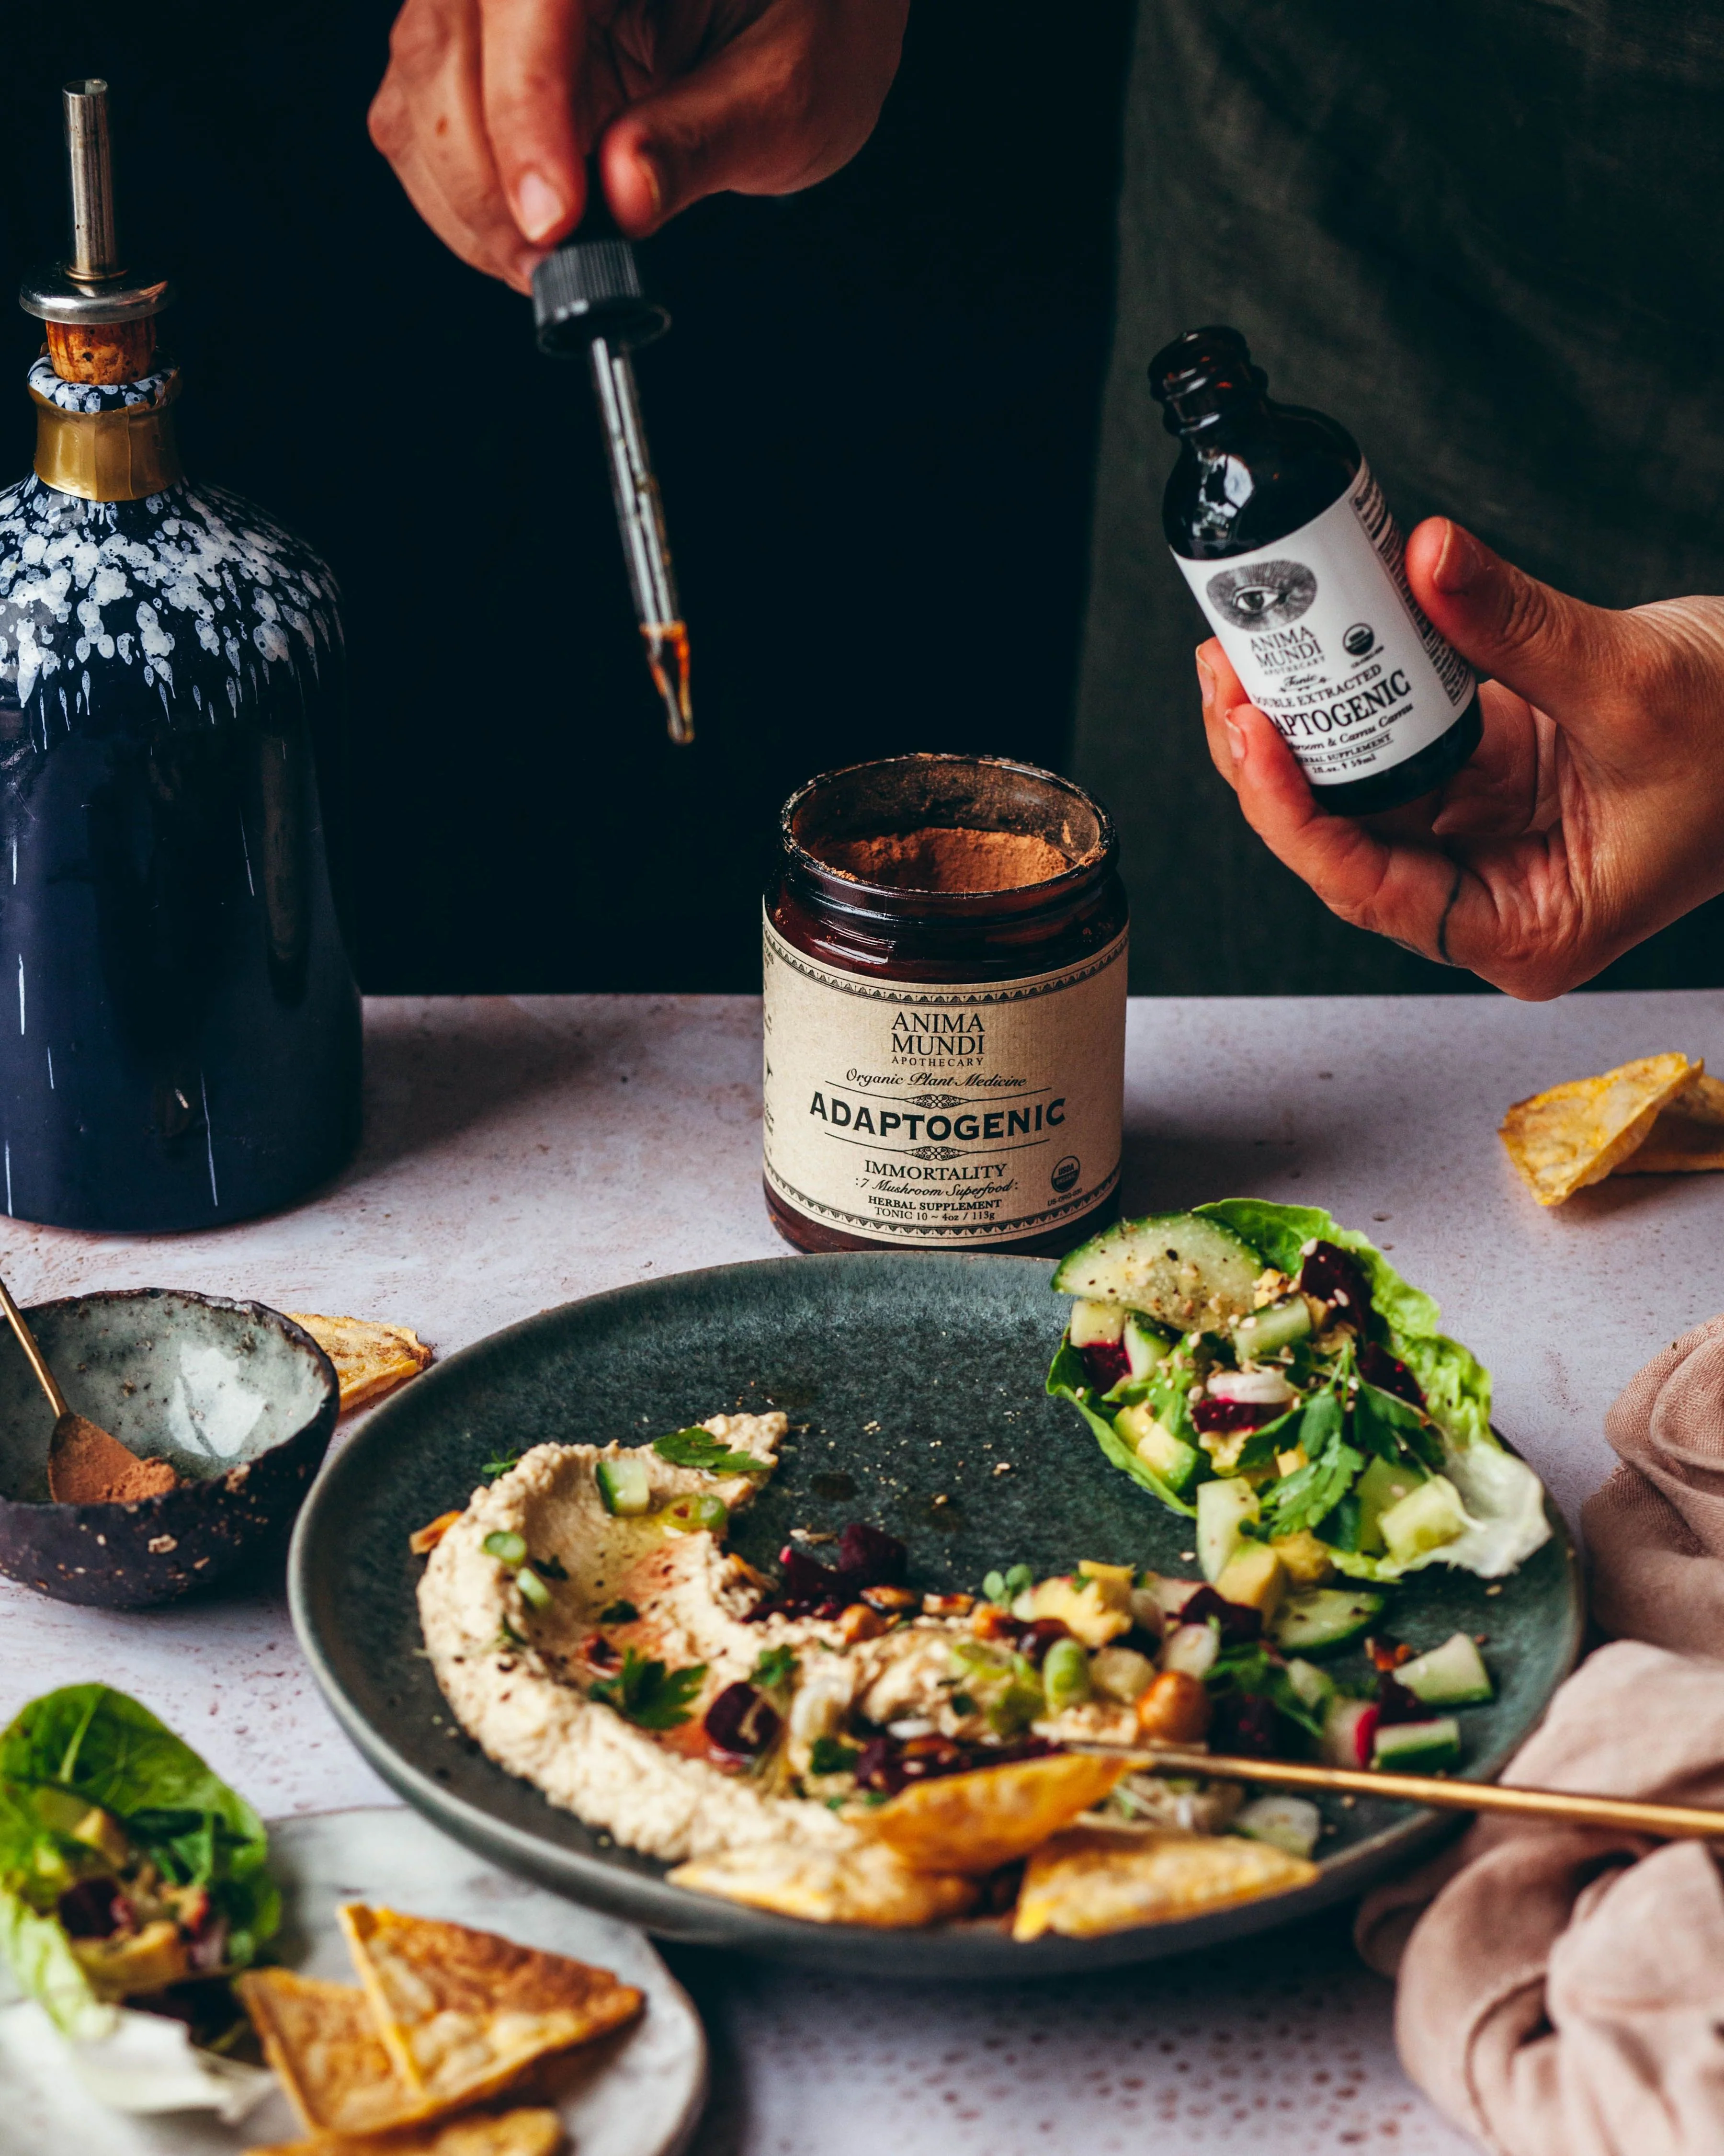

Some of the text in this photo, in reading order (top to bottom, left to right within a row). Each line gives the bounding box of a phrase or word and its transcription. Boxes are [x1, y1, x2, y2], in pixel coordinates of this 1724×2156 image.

[1250, 625, 1314, 652] ANIMA
[1255, 639, 1322, 668] MUNDI
[1283, 673, 1316, 688] Tonic
[1297, 663, 1382, 706] EXTRACTED
[1327, 737, 1338, 747] &
[1327, 733, 1392, 762] SUPPLEMENT
[891, 1012, 985, 1032] ANIMA
[891, 1033, 985, 1055] MUNDI
[892, 1057, 984, 1067] APOTHECARY
[846, 1068, 1027, 1087] Organic Plant Medicine
[809, 1091, 1066, 1141] ADAPTOGENIC
[864, 1160, 1007, 1180] IMMORTALITY
[872, 1179, 943, 1196] Mushroom
[868, 1196, 1002, 1211] HERBAL SUPPLEMENT
[874, 1207, 913, 1220] TONIC
[917, 1212, 928, 1221] 10
[942, 1213, 959, 1221] 4oz
[963, 1212, 968, 1221] /
[973, 1211, 995, 1221] 113g
